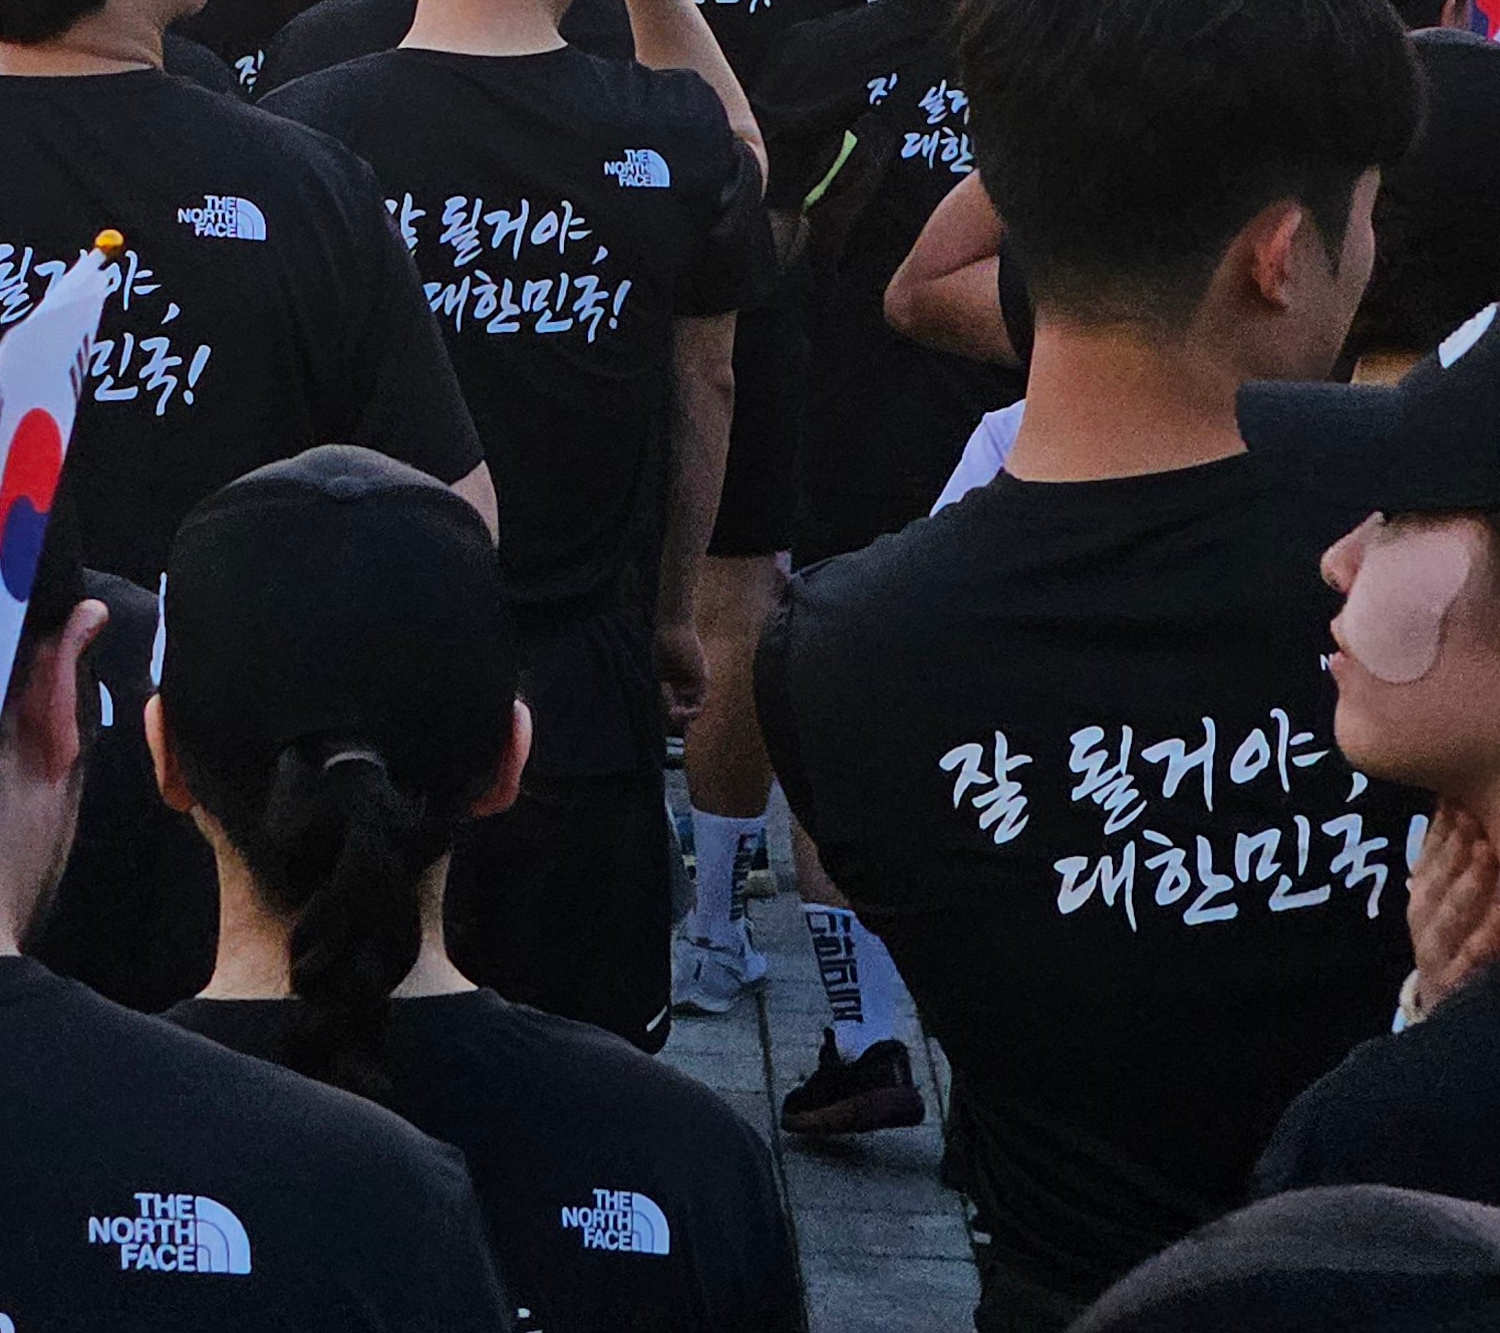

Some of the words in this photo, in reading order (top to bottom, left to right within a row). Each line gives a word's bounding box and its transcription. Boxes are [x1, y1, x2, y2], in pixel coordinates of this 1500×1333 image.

[624, 149, 649, 163] THE
[604, 160, 650, 176] NORTH
[619, 173, 651, 187] FACE
[204, 195, 236, 211] THE
[177, 208, 236, 225] NORTH
[195, 222, 236, 238] FACE
[440, 196, 609, 267] 될거야,
[939, 731, 1033, 844] 잘
[1069, 708, 1368, 835] 될거야,
[134, 1192, 195, 1220] THE
[592, 1188, 632, 1211] THE
[88, 1216, 196, 1245] NORTH
[561, 1206, 633, 1233] NORTH
[583, 1227, 633, 1251] FACE
[121, 1243, 197, 1273] FACE
